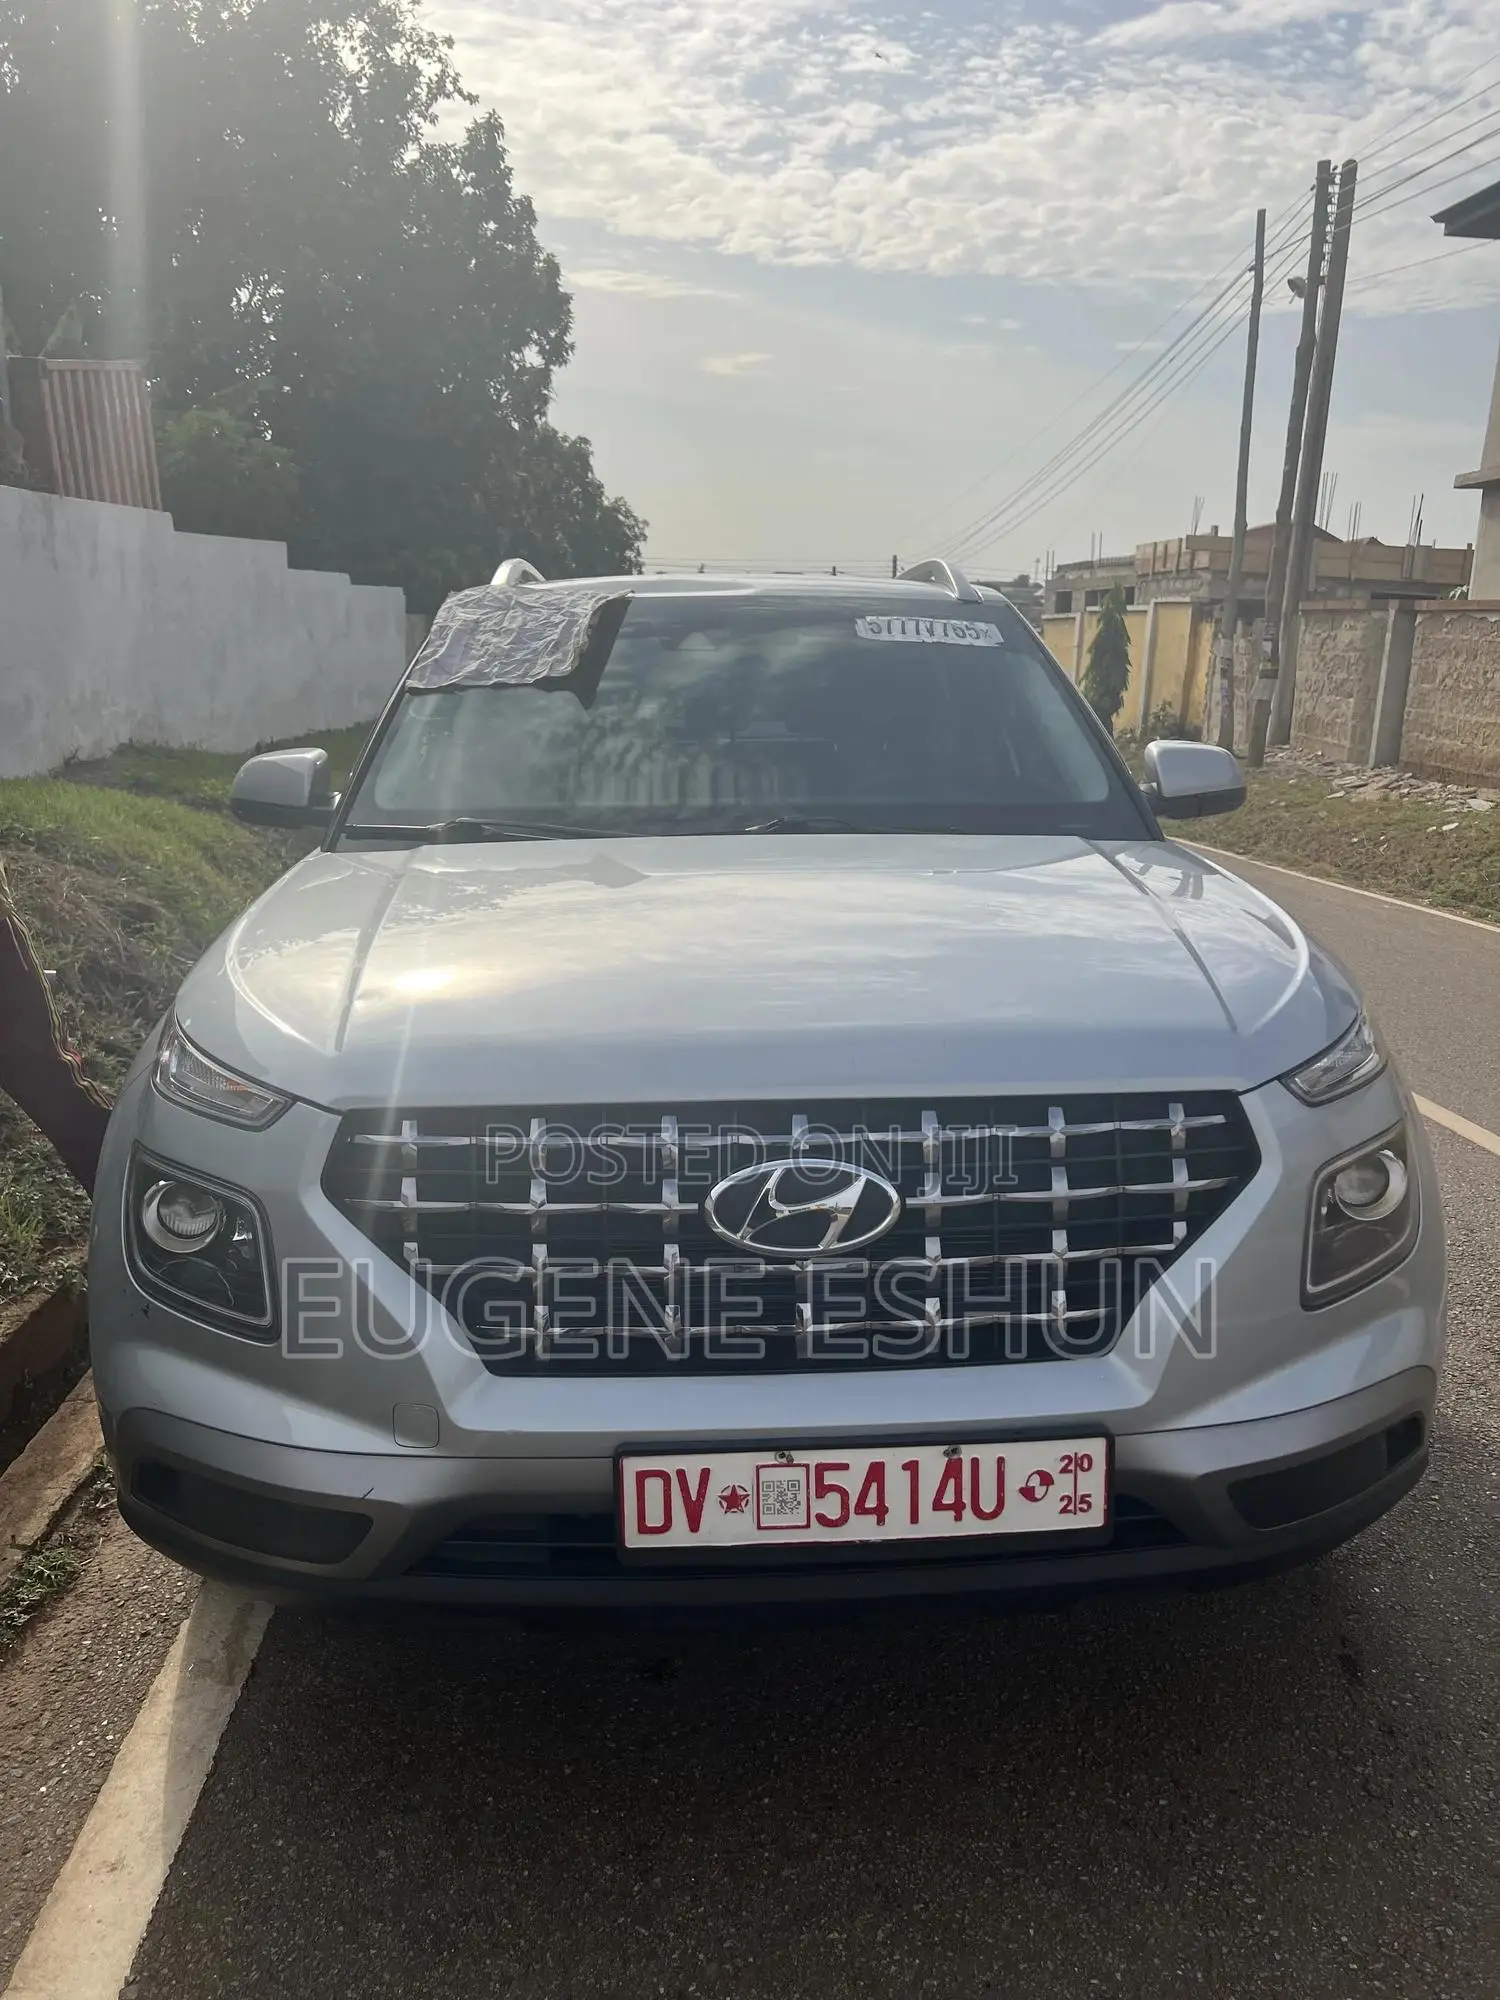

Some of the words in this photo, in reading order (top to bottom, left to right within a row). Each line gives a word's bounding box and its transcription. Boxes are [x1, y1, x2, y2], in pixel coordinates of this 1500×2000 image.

[1059, 1453, 1093, 1474] 20
[635, 1466, 711, 1535] DV
[814, 1455, 1006, 1528] 5414U
[1059, 1493, 1093, 1514] 25
